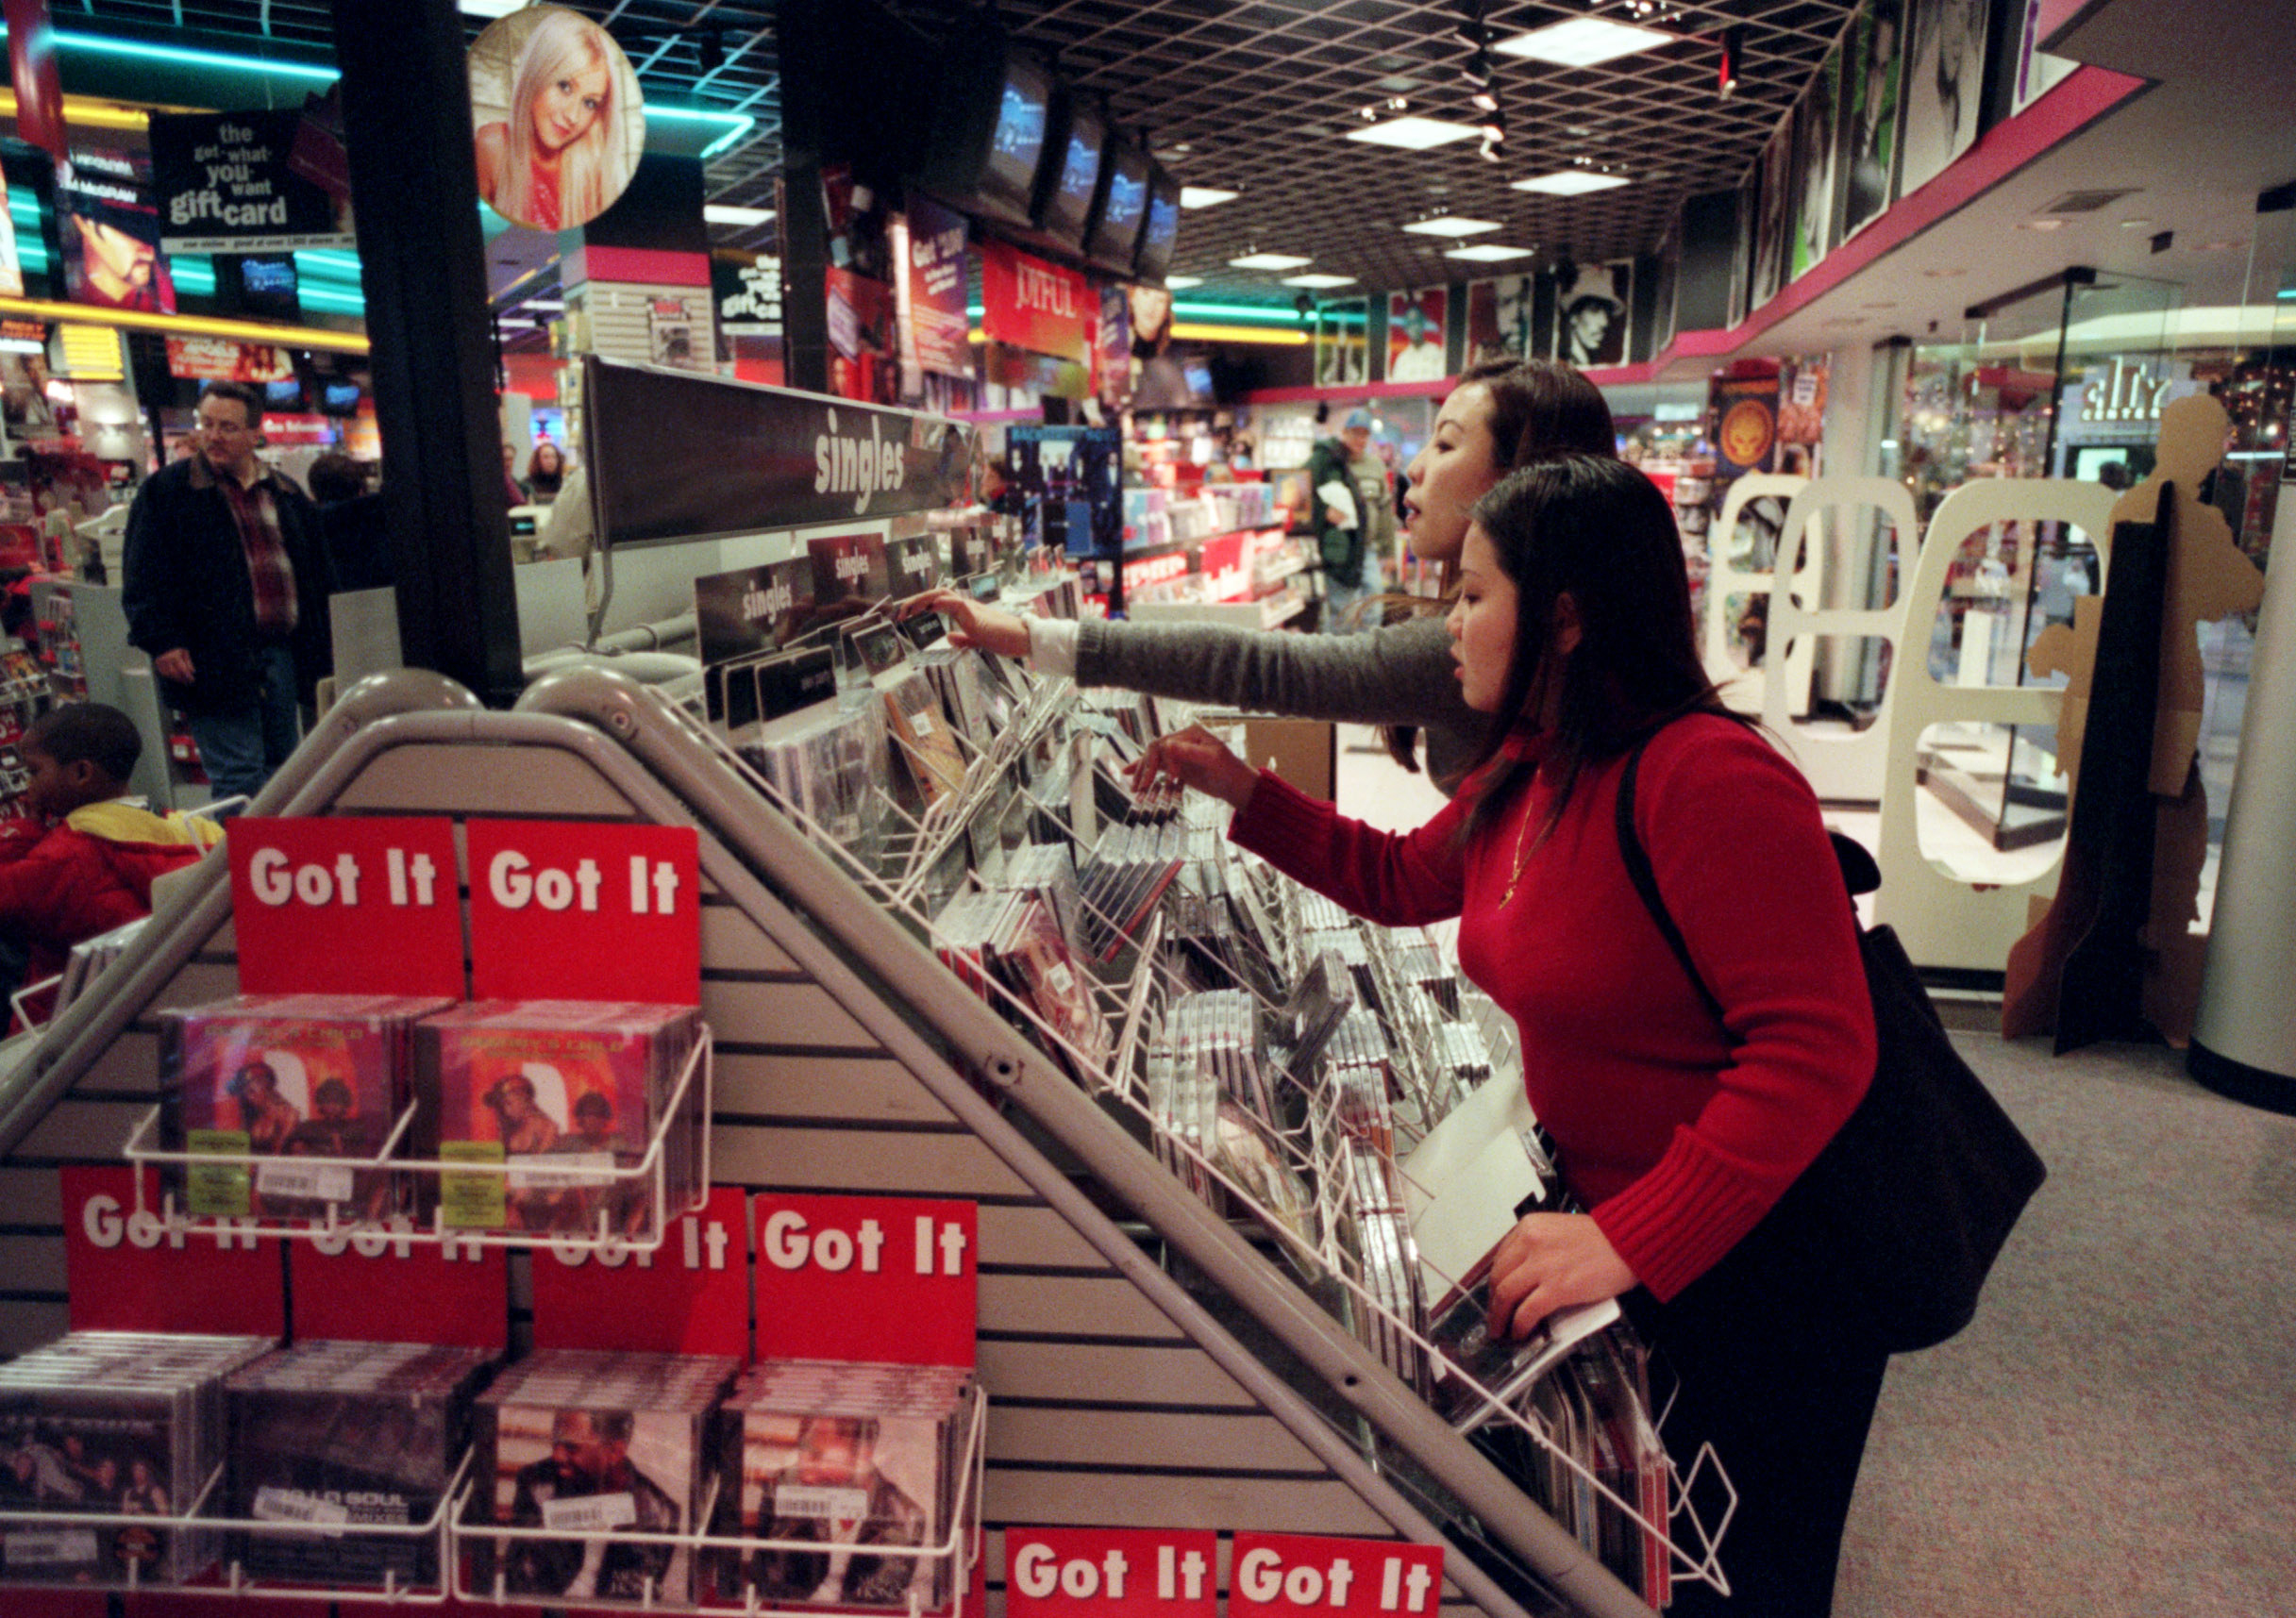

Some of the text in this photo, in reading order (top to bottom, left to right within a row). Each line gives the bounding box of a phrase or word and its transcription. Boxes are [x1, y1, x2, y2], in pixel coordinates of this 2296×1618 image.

[219, 124, 253, 142] the
[170, 190, 288, 226] gift card
[230, 178, 273, 196] want
[813, 407, 905, 515] singles
[835, 546, 870, 585] singles
[901, 542, 934, 581] singles
[743, 575, 793, 626] singles
[249, 847, 437, 907] Got It
[489, 849, 680, 915] Got It
[682, 1216, 729, 1270] It
[763, 1209, 967, 1276] Got It
[1014, 1542, 1207, 1600] Got It
[1238, 1546, 1433, 1612] Got It
